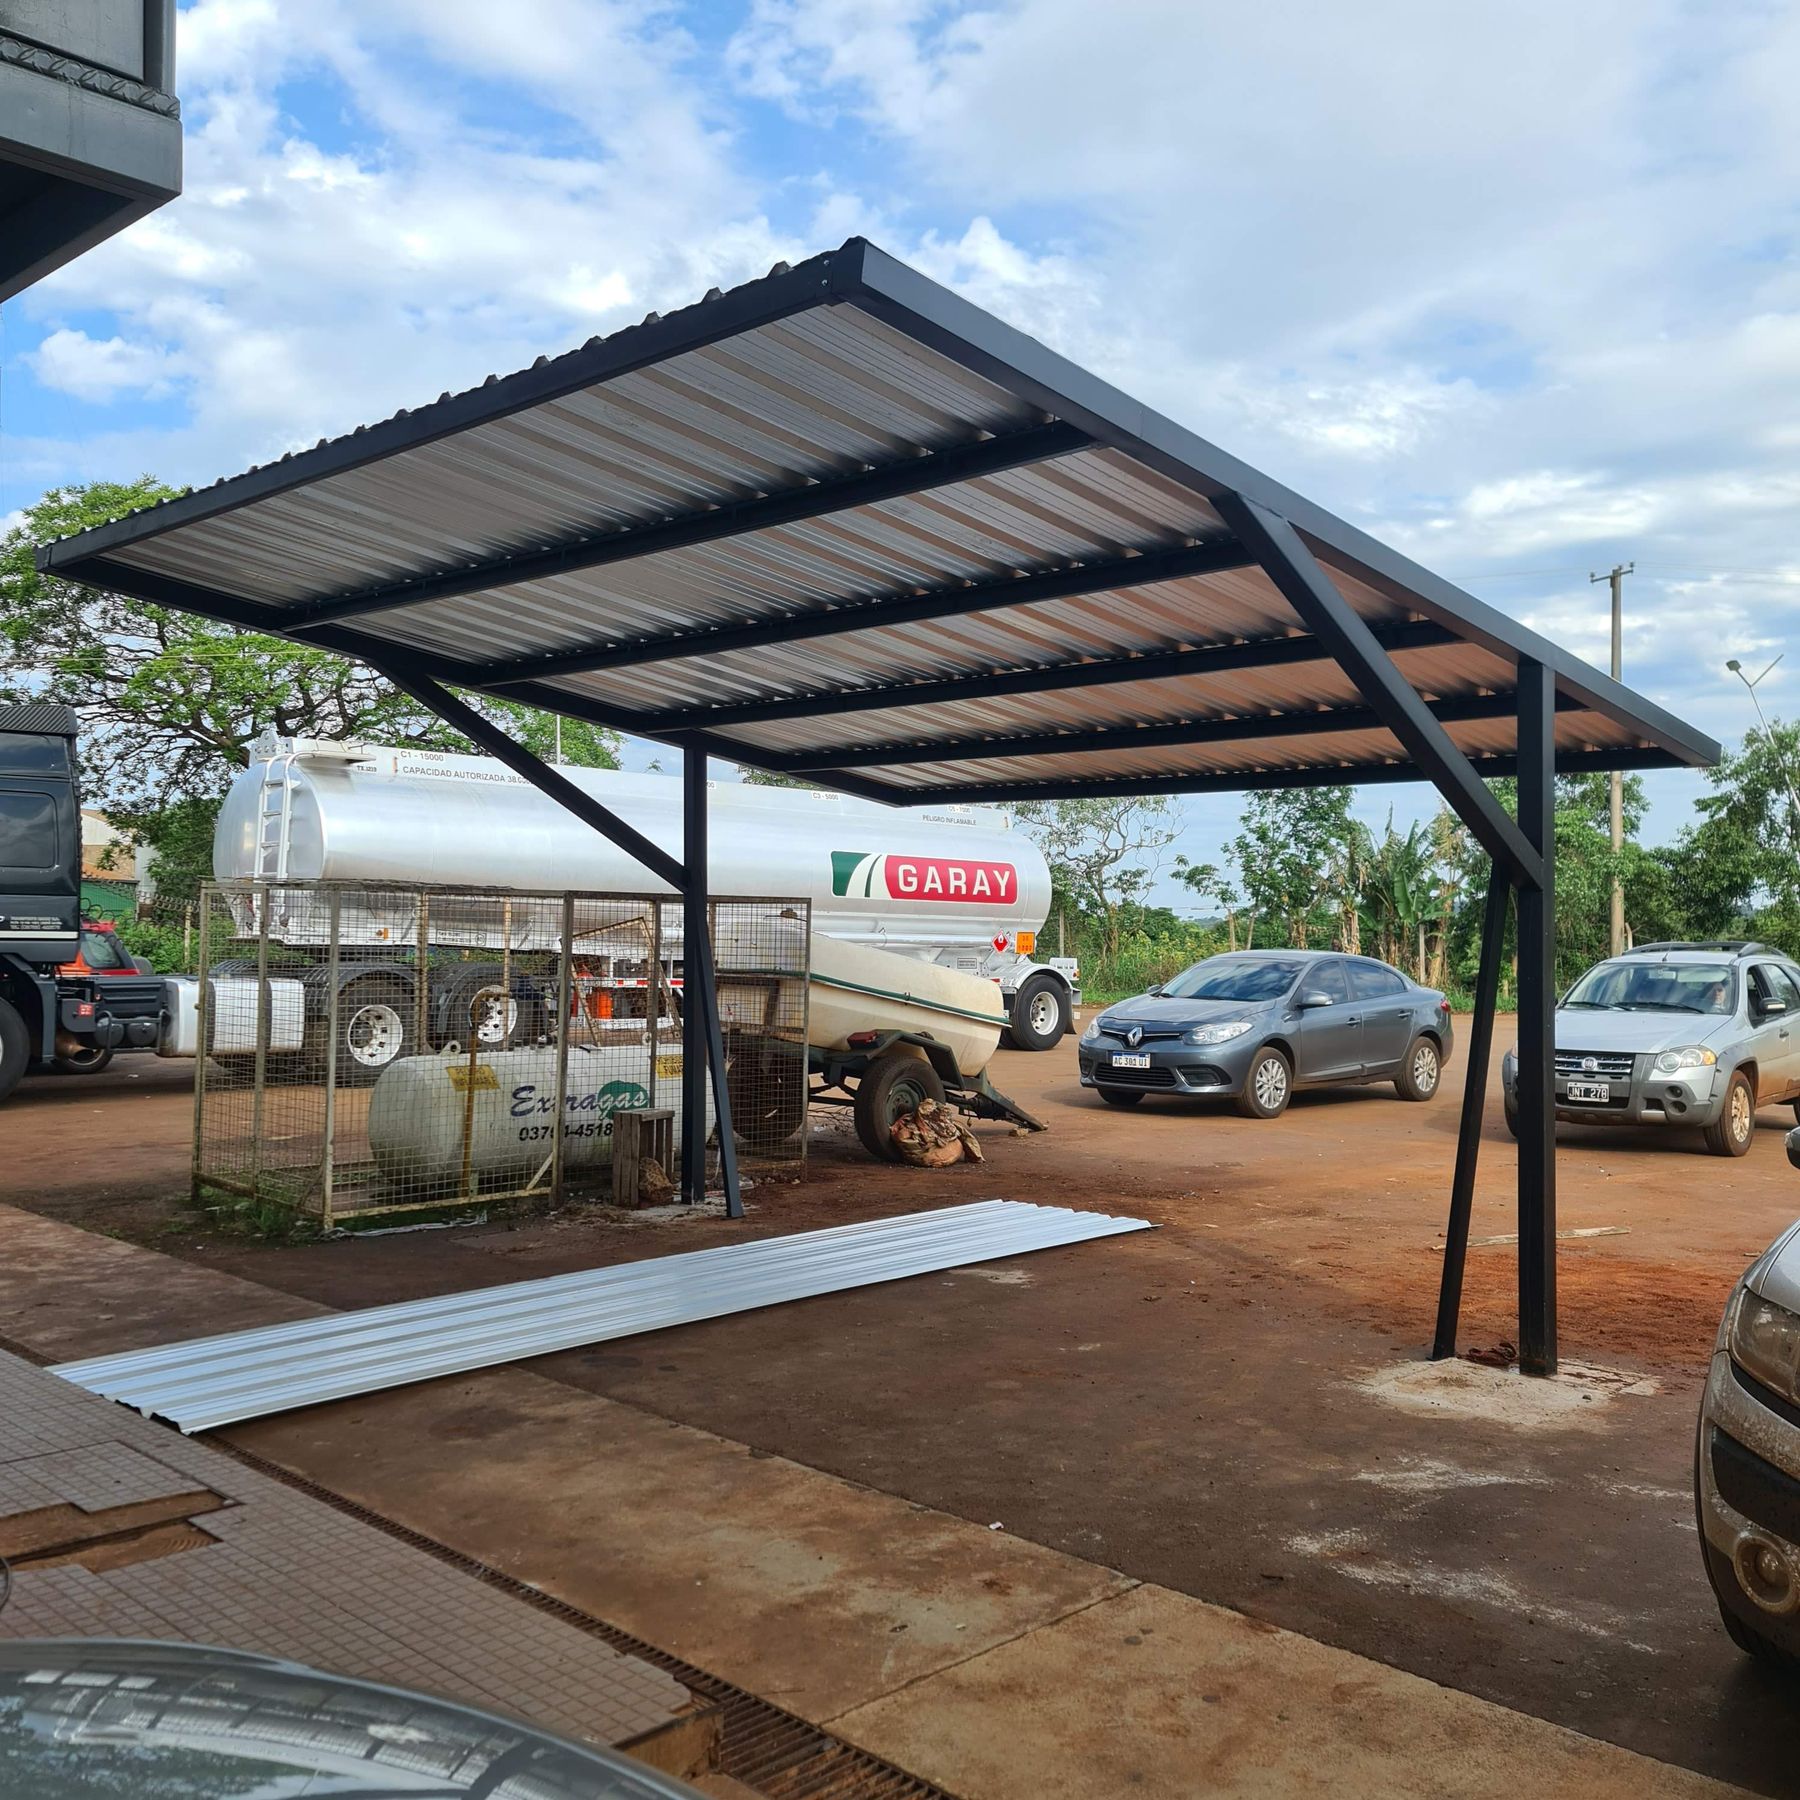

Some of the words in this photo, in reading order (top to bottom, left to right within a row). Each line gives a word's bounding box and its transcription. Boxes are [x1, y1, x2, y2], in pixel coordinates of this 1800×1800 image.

[401, 750, 412, 758] C1
[420, 753, 444, 762] 15000
[403, 766, 452, 777] CAPACIDAD
[453, 771, 506, 783] AUTORIZADA
[922, 814, 945, 823] PELIGRO
[945, 817, 977, 826] INFLAMABLE
[898, 864, 1010, 897] GARAY
[1114, 1057, 1123, 1066] AC
[1570, 1087, 1585, 1097] JNT
[1590, 1088, 1607, 1098] 278
[511, 1085, 648, 1121] Exragas
